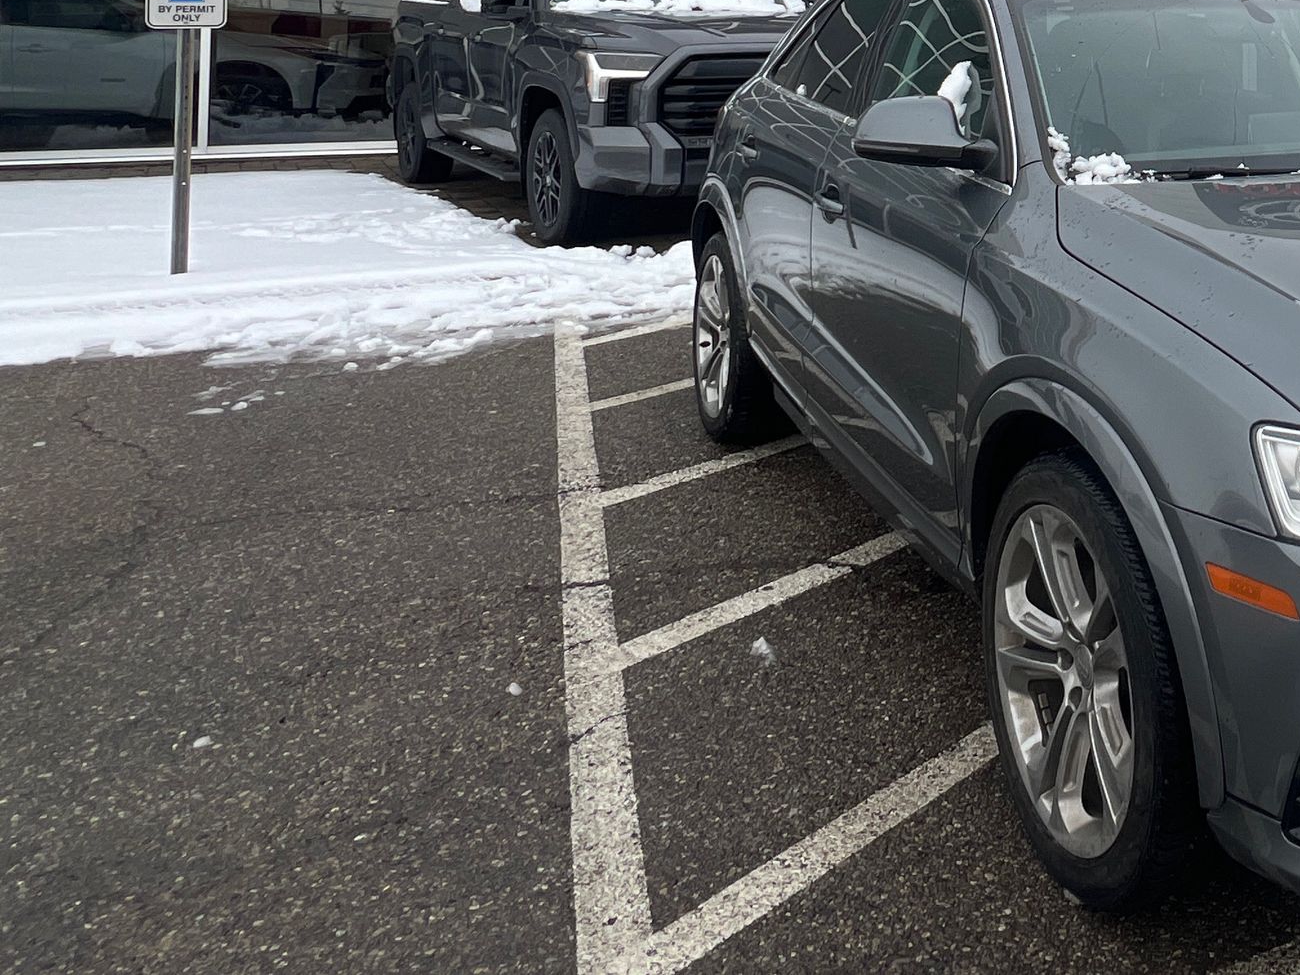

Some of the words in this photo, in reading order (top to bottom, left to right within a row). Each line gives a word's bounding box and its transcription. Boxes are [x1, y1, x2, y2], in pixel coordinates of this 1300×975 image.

[158, 5, 172, 13] BY
[175, 5, 216, 13] PERMIT
[172, 14, 201, 22] ONLY
